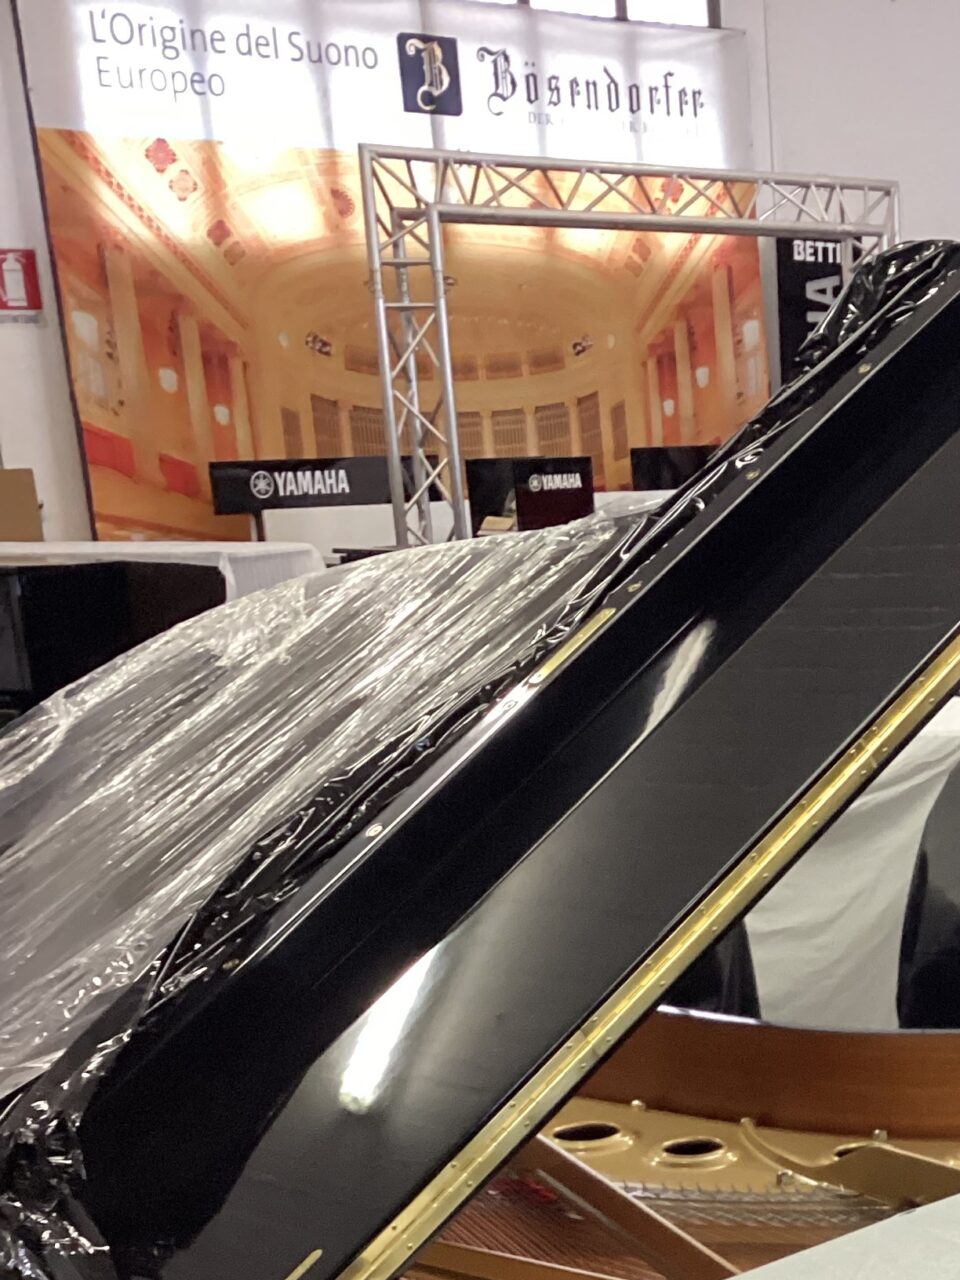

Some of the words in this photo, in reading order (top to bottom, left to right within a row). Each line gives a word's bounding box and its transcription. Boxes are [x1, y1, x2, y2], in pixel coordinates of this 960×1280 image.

[235, 23, 279, 59] del
[288, 30, 379, 70] Suono
[95, 55, 226, 103] Europeo
[475, 45, 705, 118] Bösendorfer
[274, 469, 351, 497] YAMAHA
[541, 471, 583, 490] YAMAHA
